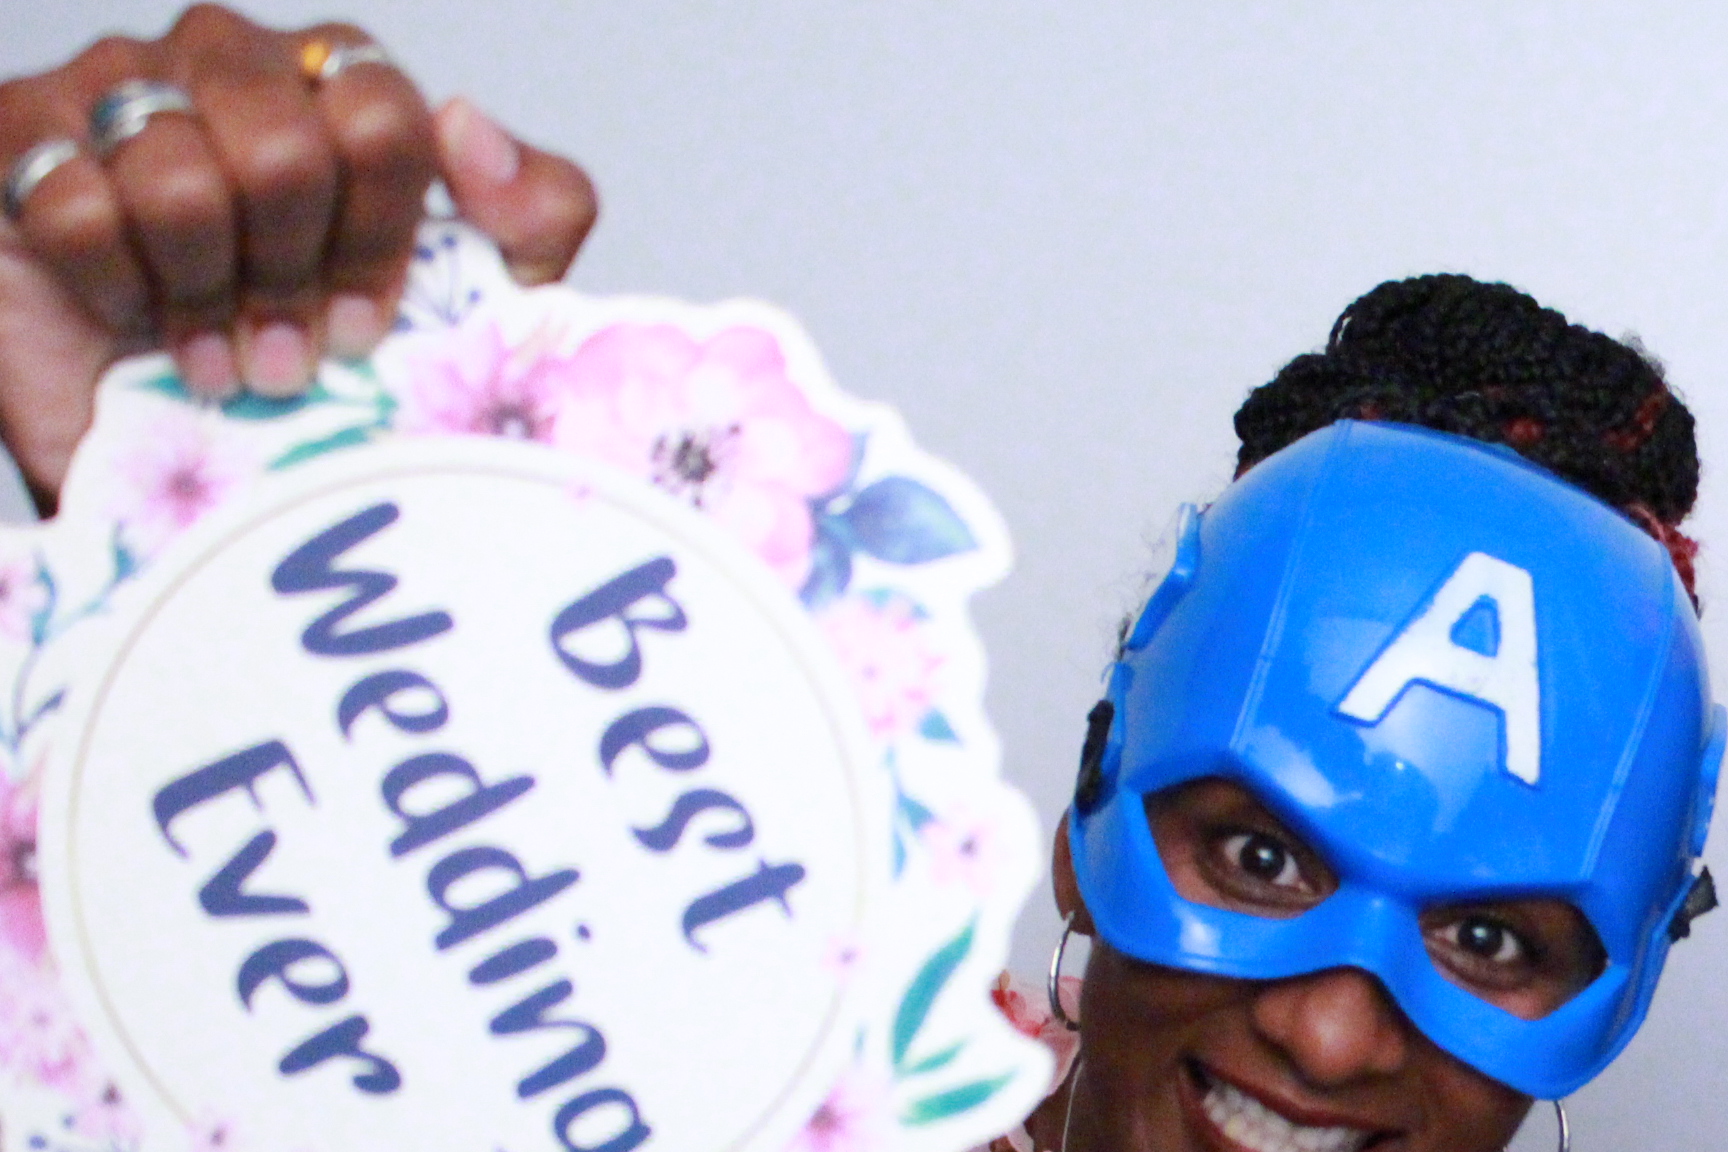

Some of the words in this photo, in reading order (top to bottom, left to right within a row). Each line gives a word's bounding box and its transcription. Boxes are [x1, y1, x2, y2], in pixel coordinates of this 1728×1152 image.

[549, 555, 806, 953] Best
[1335, 549, 1542, 789] A
[151, 737, 402, 1096] Ever
